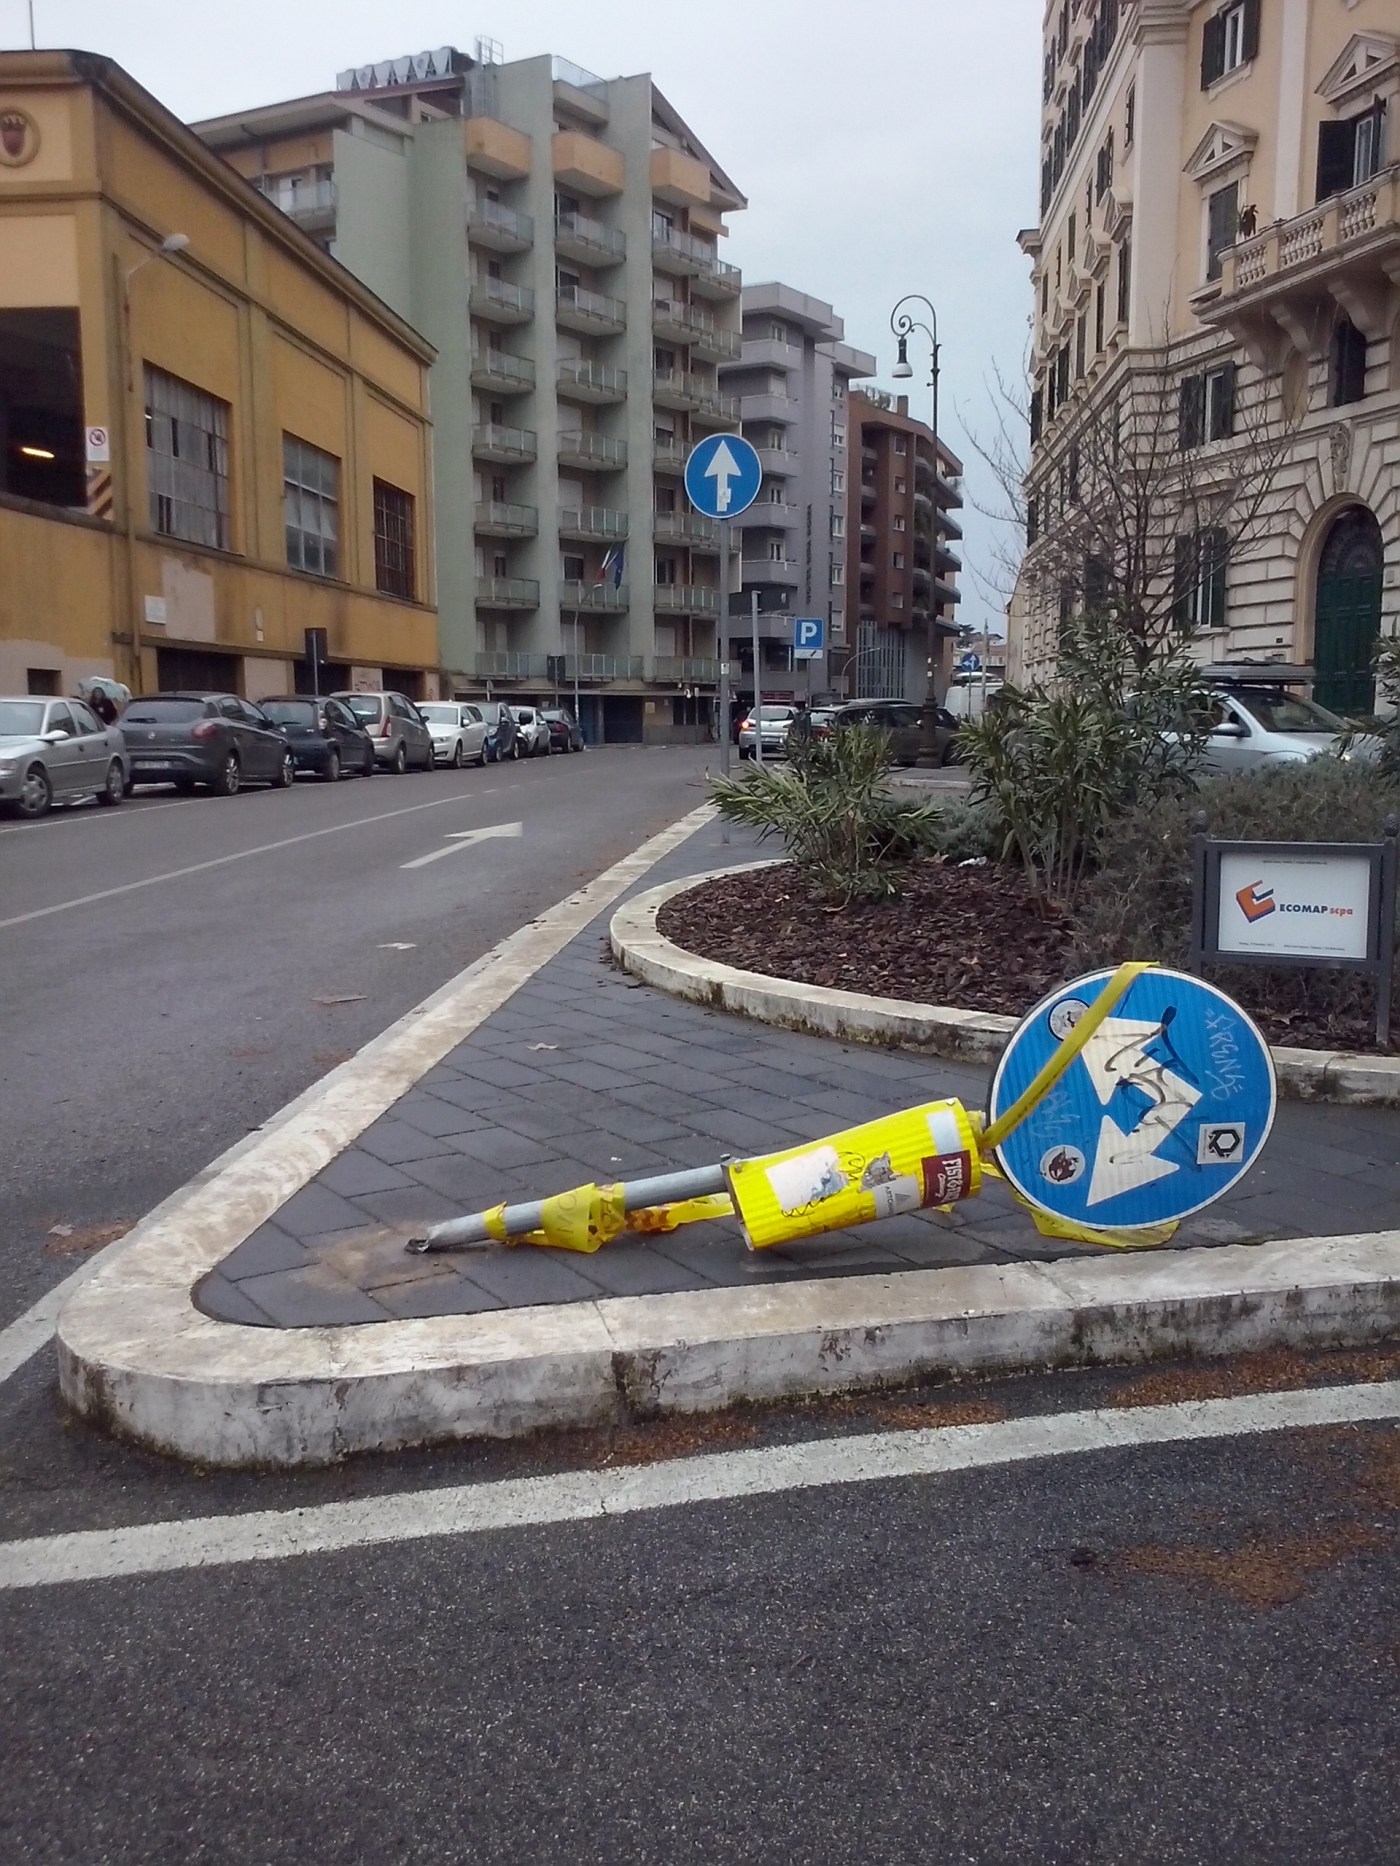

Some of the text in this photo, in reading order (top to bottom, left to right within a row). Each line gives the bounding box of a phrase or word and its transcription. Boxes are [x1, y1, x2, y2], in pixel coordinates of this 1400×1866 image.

[801, 622, 817, 645] P
[1279, 903, 1353, 917] ECOMAP scpa
